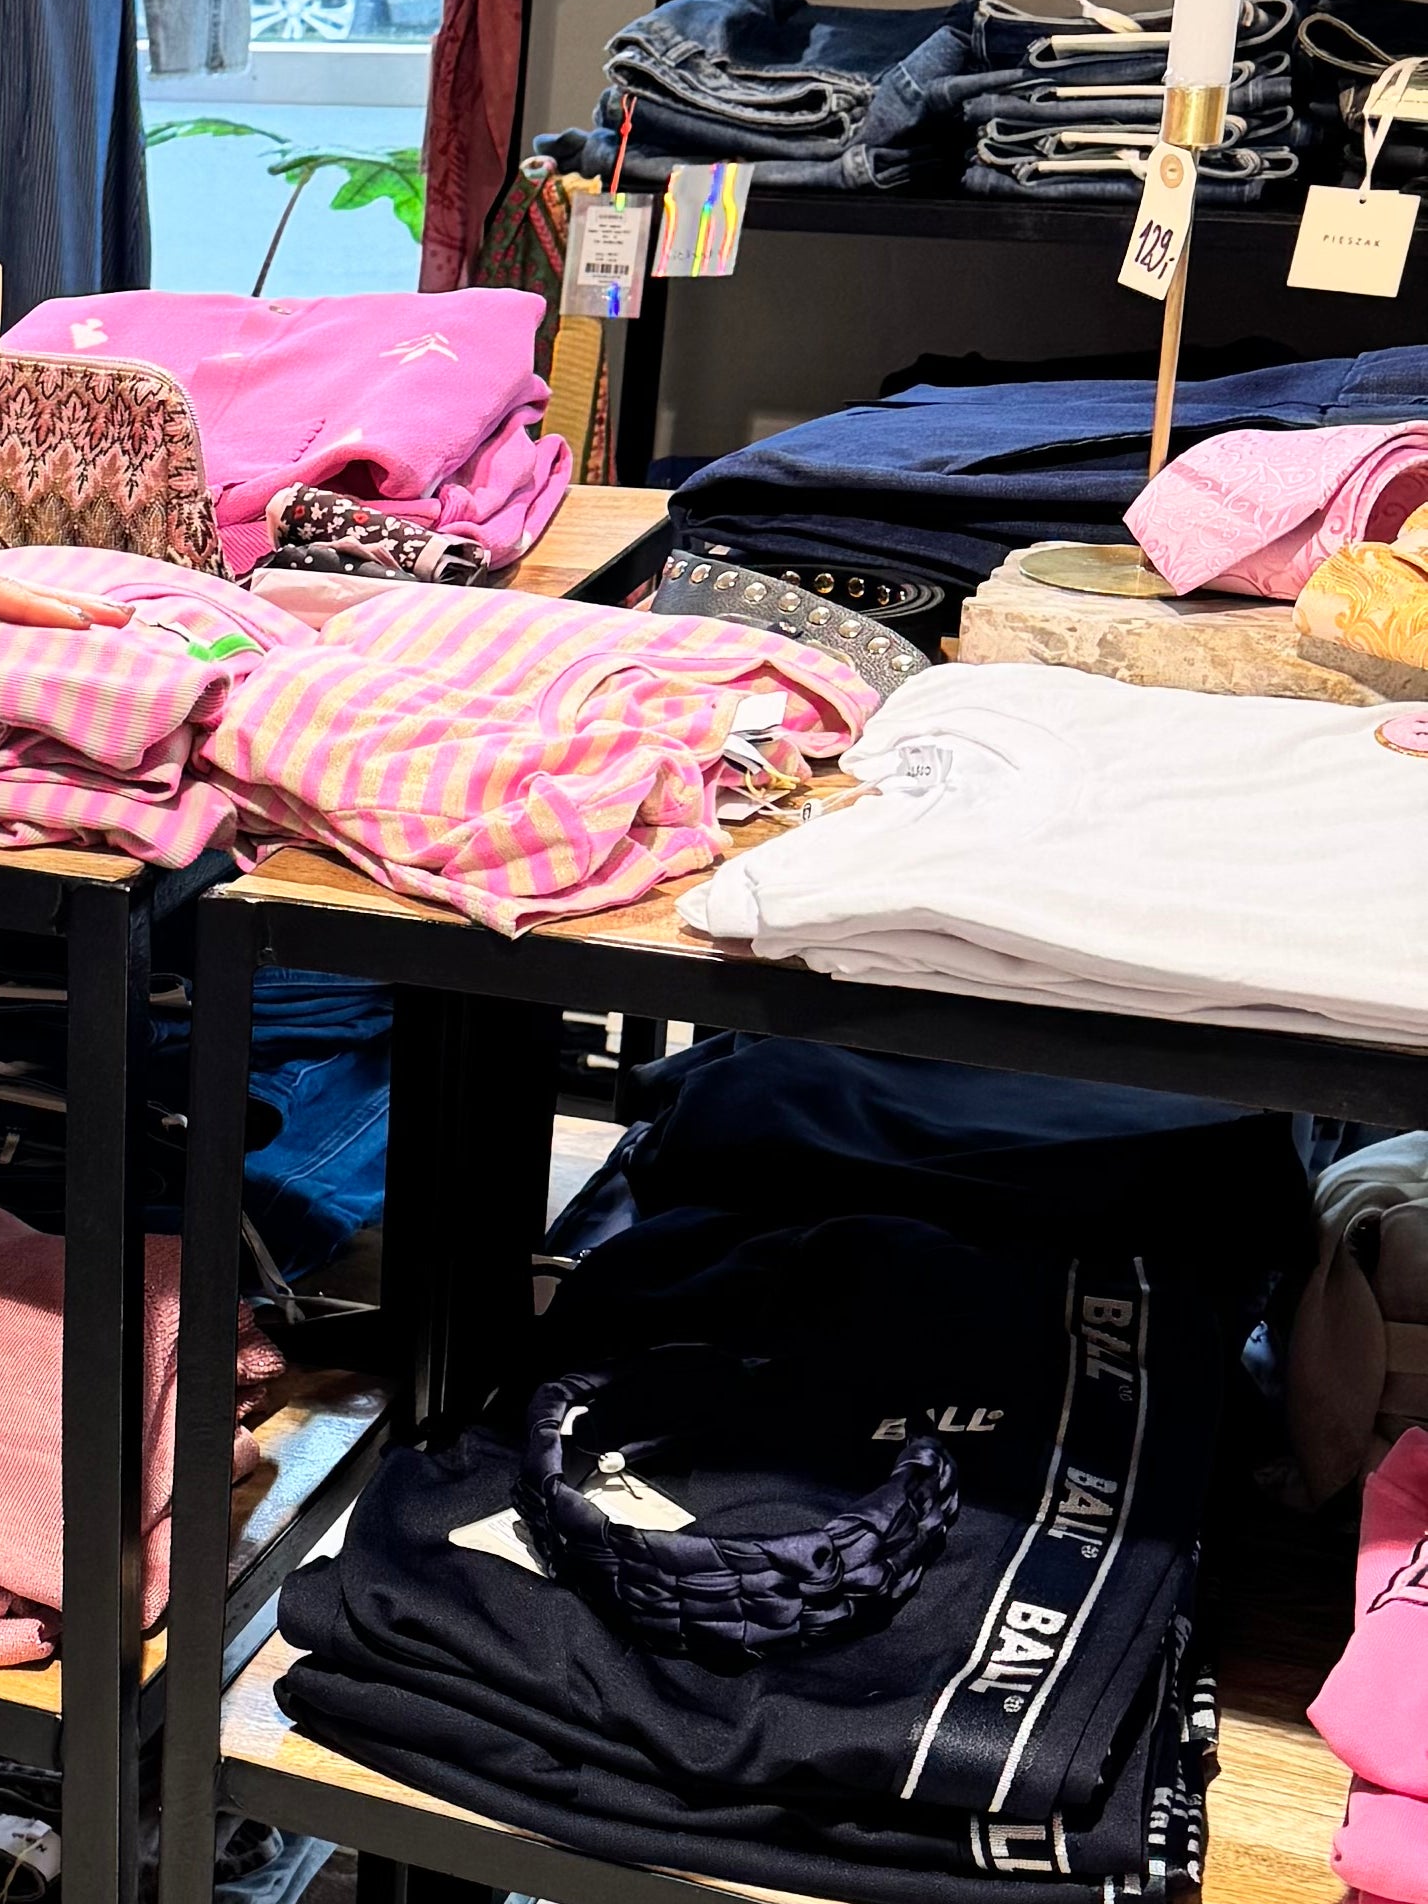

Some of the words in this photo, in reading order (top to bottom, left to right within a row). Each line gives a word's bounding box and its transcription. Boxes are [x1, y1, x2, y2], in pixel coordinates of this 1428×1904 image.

[1322, 233, 1382, 248] PIESZAK
[871, 1406, 996, 1441] BLL
[1047, 1466, 1119, 1547] BALL
[968, 1600, 1068, 1694] BALL
